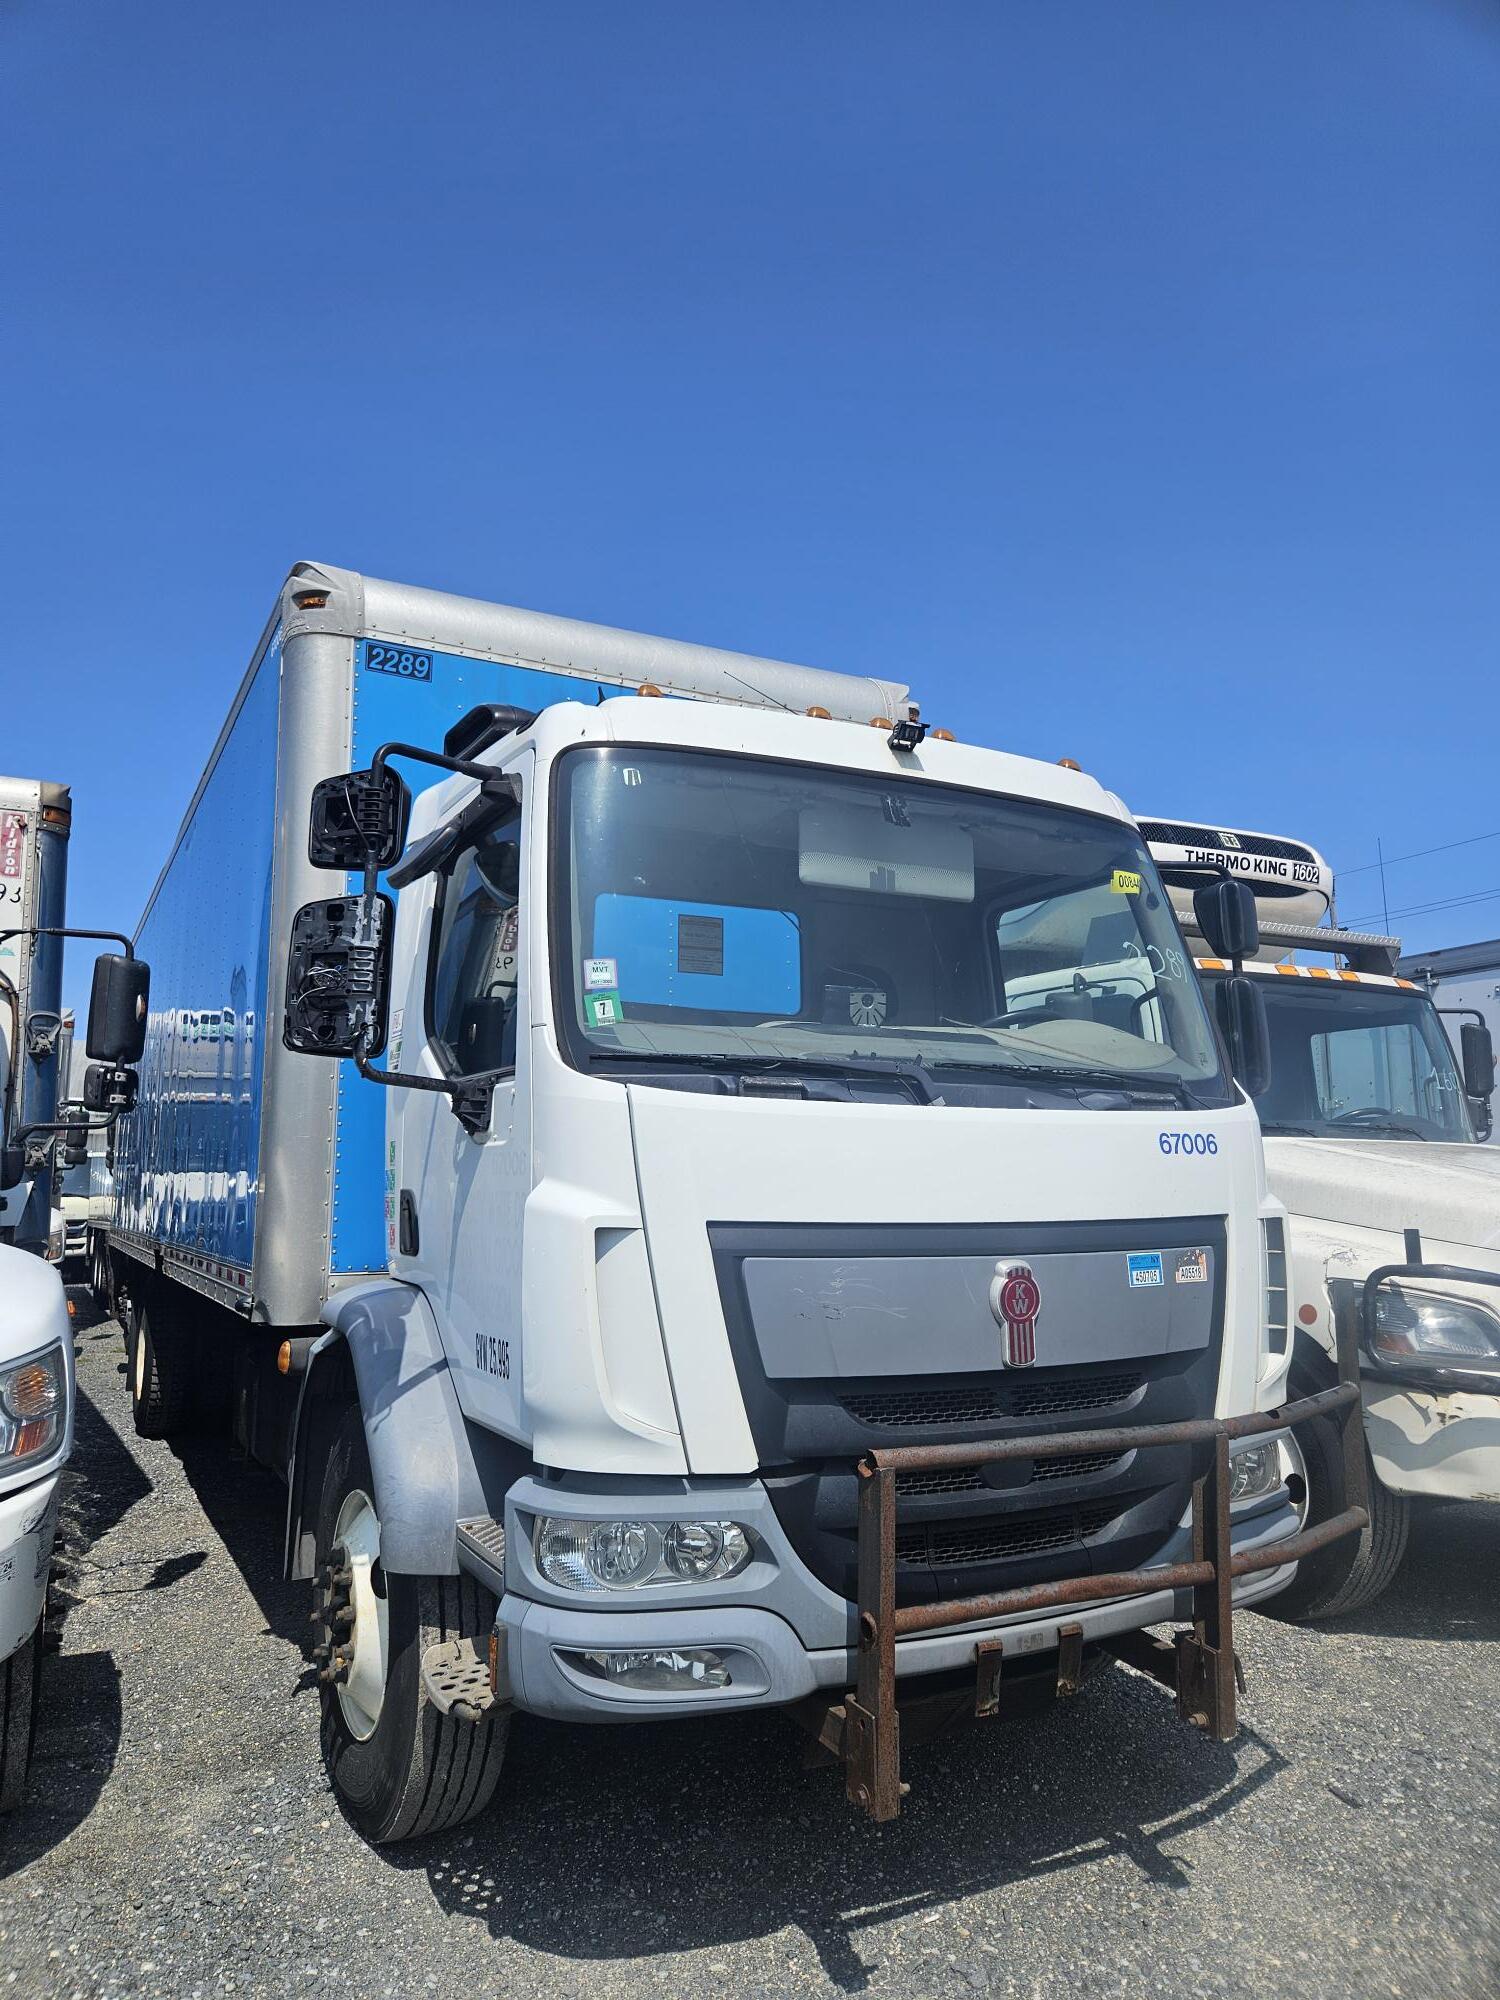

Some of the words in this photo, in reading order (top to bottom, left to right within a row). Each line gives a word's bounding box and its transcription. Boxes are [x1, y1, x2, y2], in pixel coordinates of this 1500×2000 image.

[369, 647, 430, 678] 2289
[1185, 849, 1251, 871] THERMO
[1253, 859, 1288, 877] KING
[1293, 863, 1319, 883] 1602
[599, 1002, 607, 1016] 7
[1159, 1132, 1218, 1155] 67006
[475, 1332, 488, 1372] GVW
